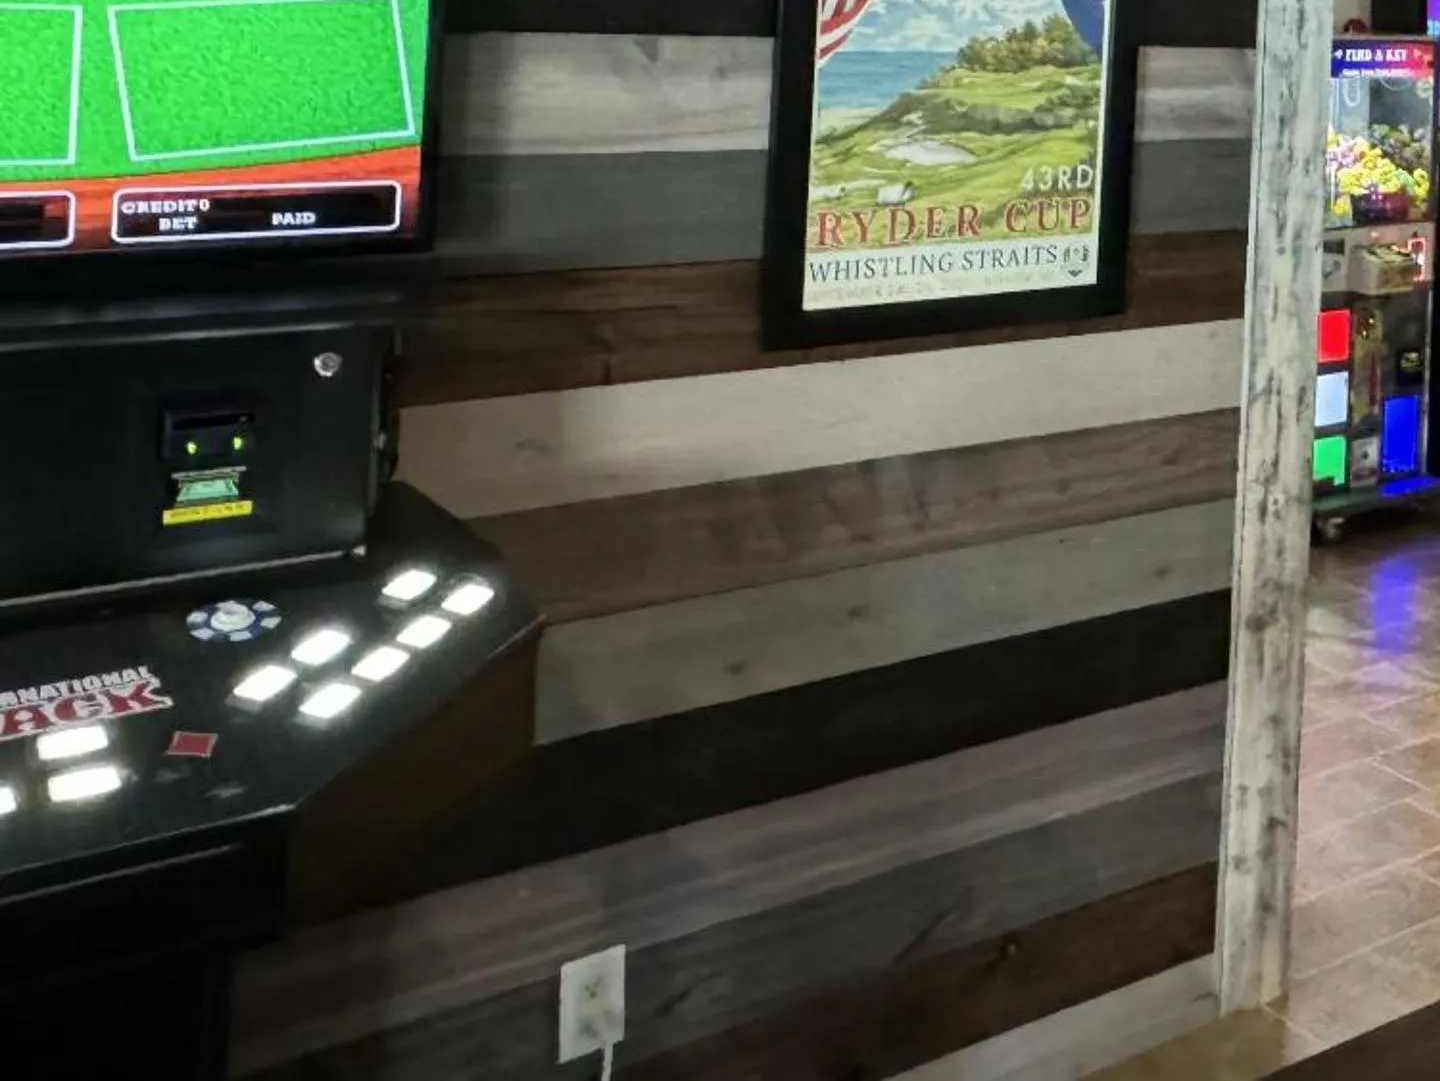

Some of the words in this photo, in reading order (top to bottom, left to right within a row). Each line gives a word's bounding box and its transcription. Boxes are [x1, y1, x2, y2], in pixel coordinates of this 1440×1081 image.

[1019, 163, 1094, 192] 43RD
[158, 215, 198, 232] BET
[271, 211, 317, 226] PAID
[815, 202, 983, 247] RYDER
[1003, 195, 1094, 234] CUP
[808, 253, 954, 283] WHISTLING
[961, 244, 1059, 272] STRAITS
